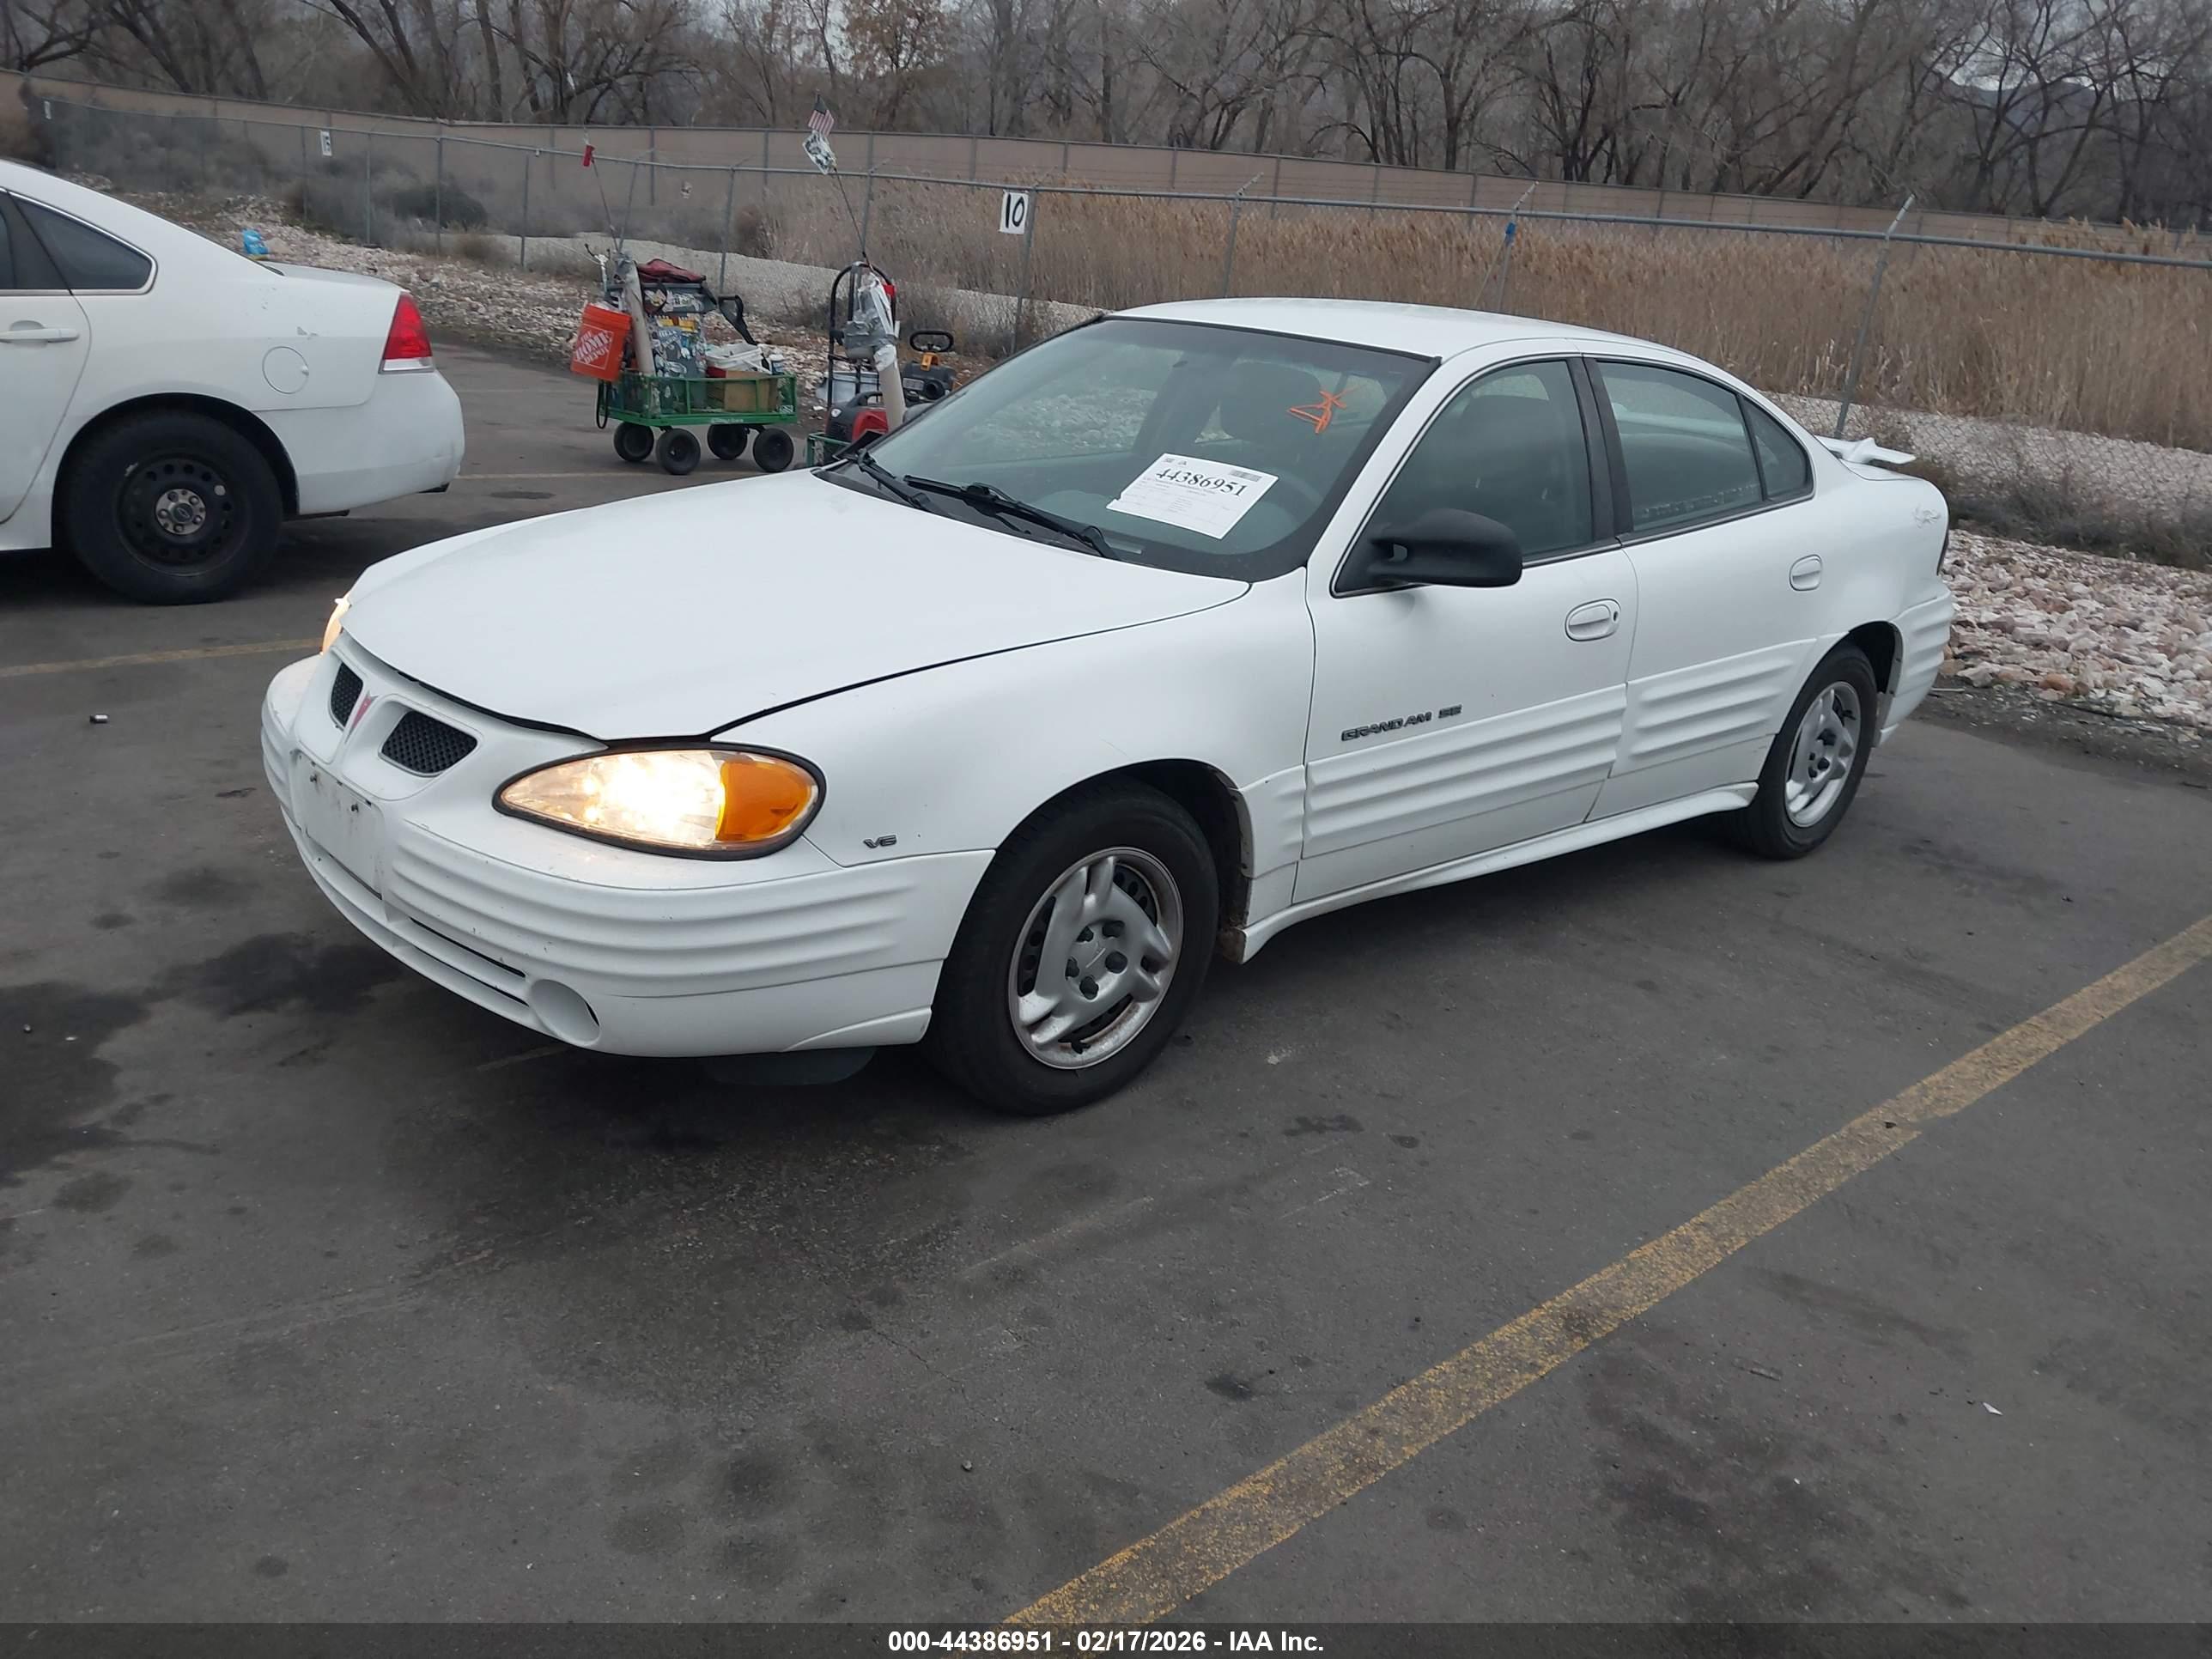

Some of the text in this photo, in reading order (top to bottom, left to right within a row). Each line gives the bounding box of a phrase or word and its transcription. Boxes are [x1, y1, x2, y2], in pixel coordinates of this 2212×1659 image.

[1006, 193, 1025, 228] 10
[576, 331, 612, 361] HOME
[1156, 468, 1247, 497] 44386951
[1341, 718, 1403, 741] GRAND
[1404, 711, 1432, 727] AM
[862, 834, 897, 848] V6
